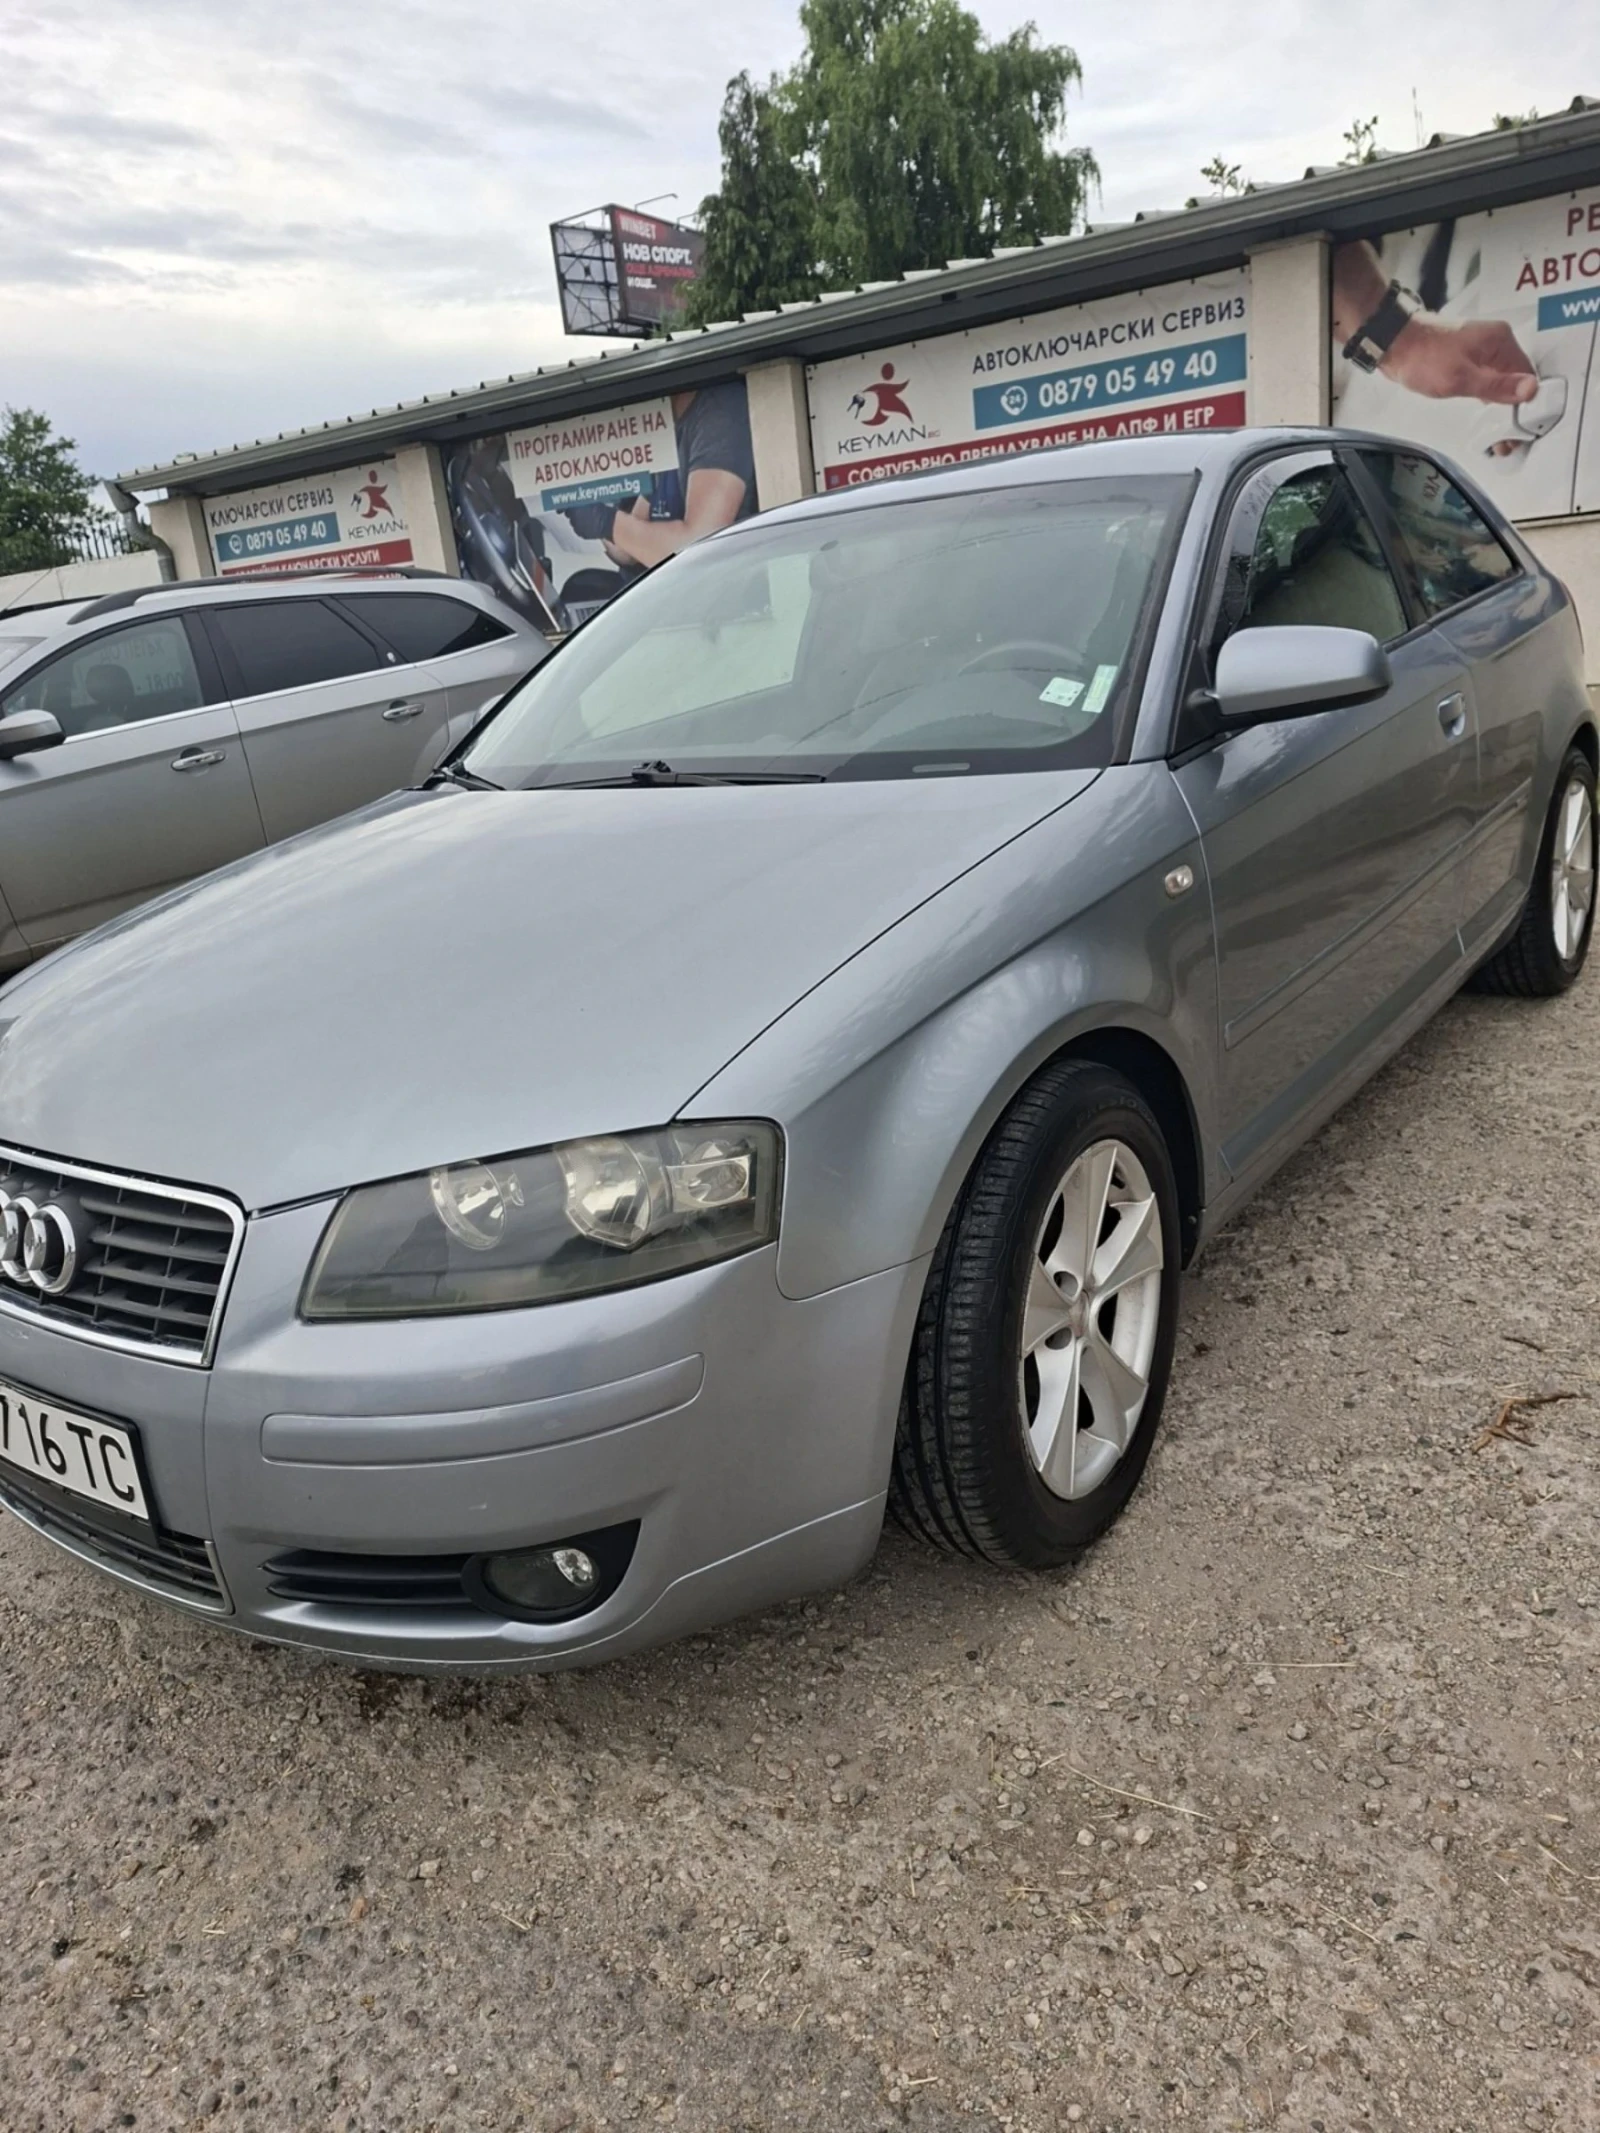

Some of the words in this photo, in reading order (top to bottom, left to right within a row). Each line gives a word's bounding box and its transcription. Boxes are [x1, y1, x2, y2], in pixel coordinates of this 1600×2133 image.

[1567, 203, 1600, 237] РЕ
[623, 242, 650, 262] НОВ
[1515, 248, 1600, 291] АВТО
[972, 317, 1154, 375] АВТОКЛЮЧАРСКИ
[1162, 297, 1245, 334] СЕРВИЗ
[1038, 373, 1097, 408] 0879
[1105, 366, 1136, 395] 05
[1144, 358, 1175, 386] 49
[1183, 350, 1217, 377] 40
[514, 416, 638, 459] ПРОГРАМИРАНЕ
[643, 411, 668, 433] НА
[838, 425, 926, 456] KEYMAN
[1083, 425, 1108, 442] НА
[1115, 417, 1158, 437] ЛПФ
[1164, 412, 1176, 431] И
[1183, 406, 1215, 429] ЕГР
[534, 444, 653, 485] АВТОКЛЮЧОВЕ
[210, 499, 285, 528] КЛЮЧАРСКИ
[287, 488, 334, 512] СЕРВИЗ
[551, 479, 641, 506] www.keyman.bg
[246, 530, 273, 551] 0879
[276, 527, 291, 546] 05
[294, 523, 307, 542] 49
[311, 520, 327, 538] 40
[341, 549, 381, 567] УСЛУГИ
